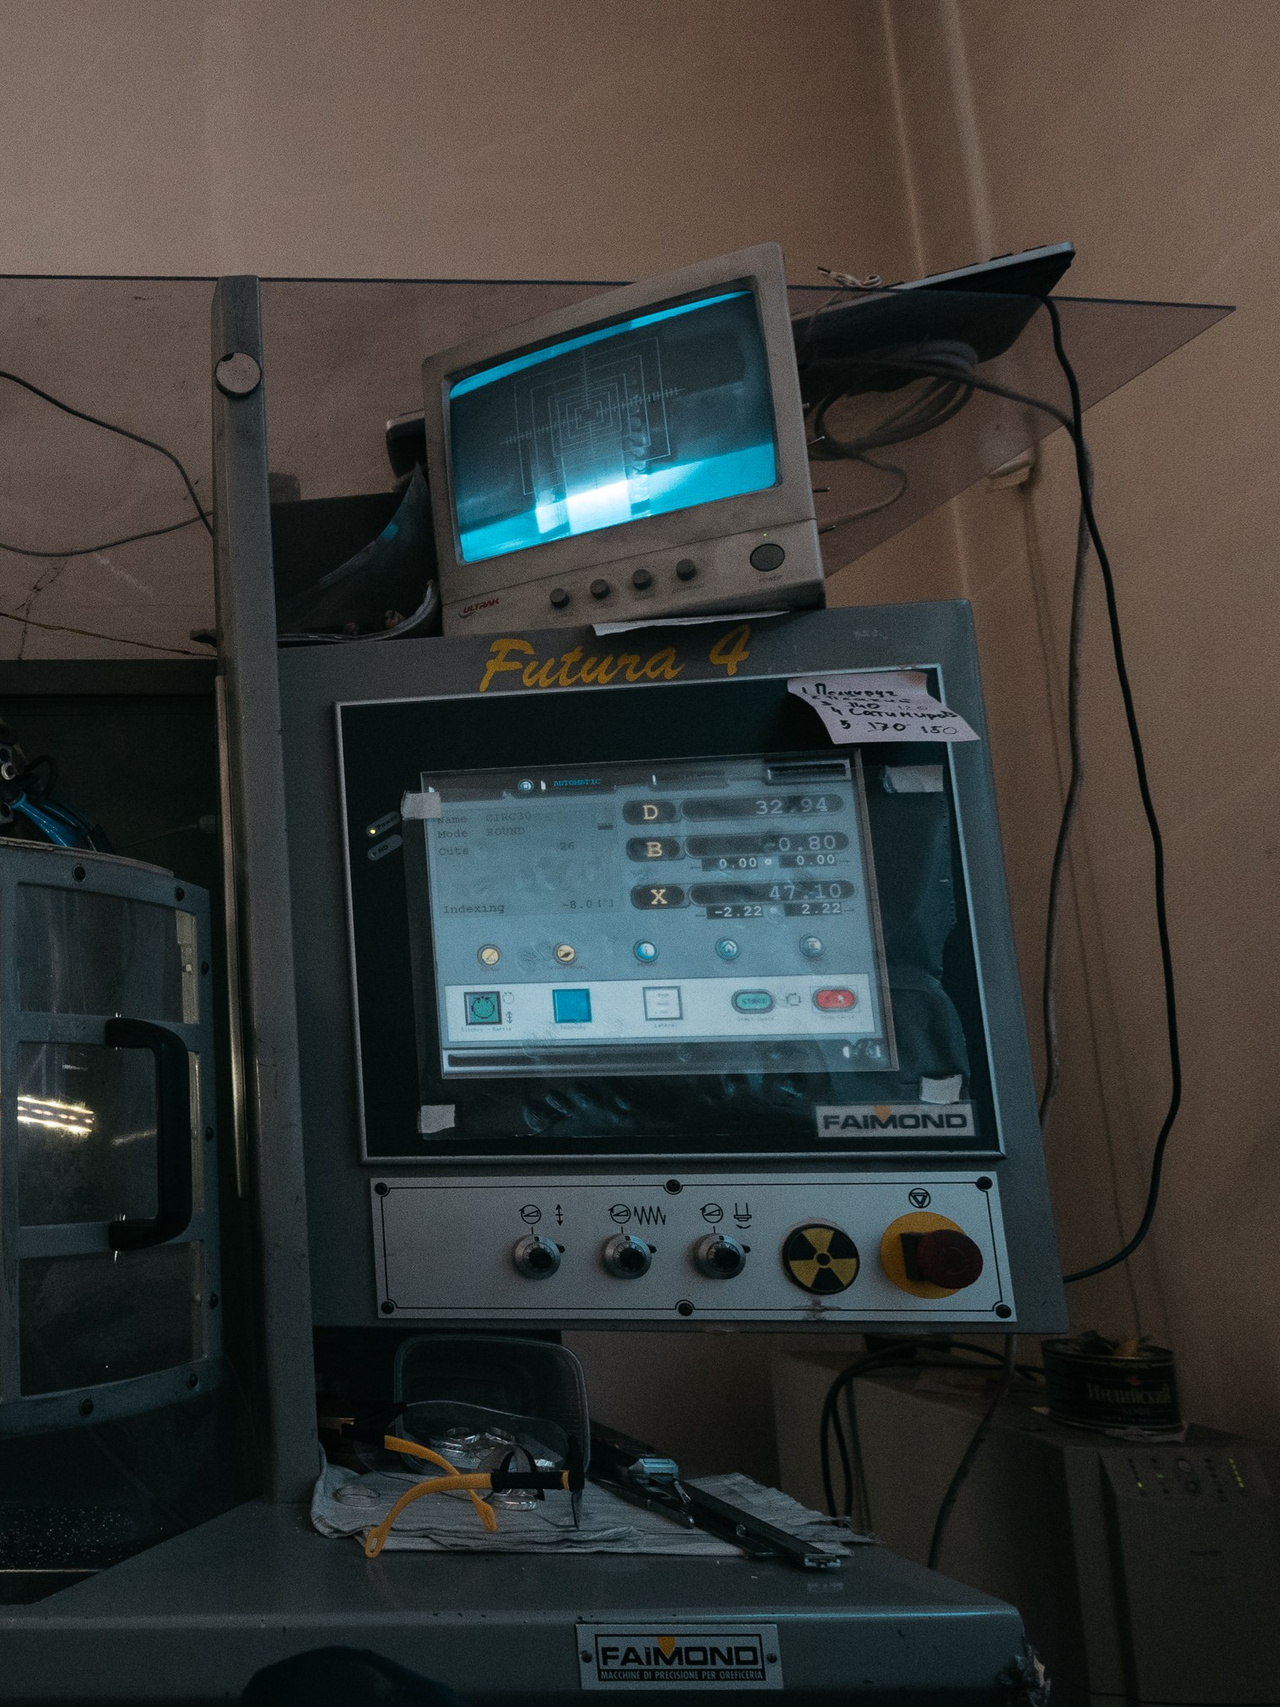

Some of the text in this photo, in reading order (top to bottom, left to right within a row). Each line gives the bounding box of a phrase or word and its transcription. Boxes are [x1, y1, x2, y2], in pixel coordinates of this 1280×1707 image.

[463, 598, 500, 614] ULTRAK
[479, 624, 751, 693] Futura 4
[921, 726, 958, 735] 150
[553, 778, 601, 788] AUTOMATIC
[642, 796, 828, 821] D 32.94
[437, 814, 468, 825] Name
[437, 826, 526, 839] Mode ROUND
[438, 841, 576, 857] Cuts 26
[646, 841, 663, 858] B
[719, 857, 757, 869] 0.00
[796, 854, 835, 866] 0.00
[650, 883, 842, 905] X 47.10
[443, 903, 505, 916] Indexing
[714, 905, 763, 918] -2.22
[801, 902, 842, 915] 2.22
[601, 1670, 763, 1680] MACCHINE DI PRECISIONE PER OREFICERIA
